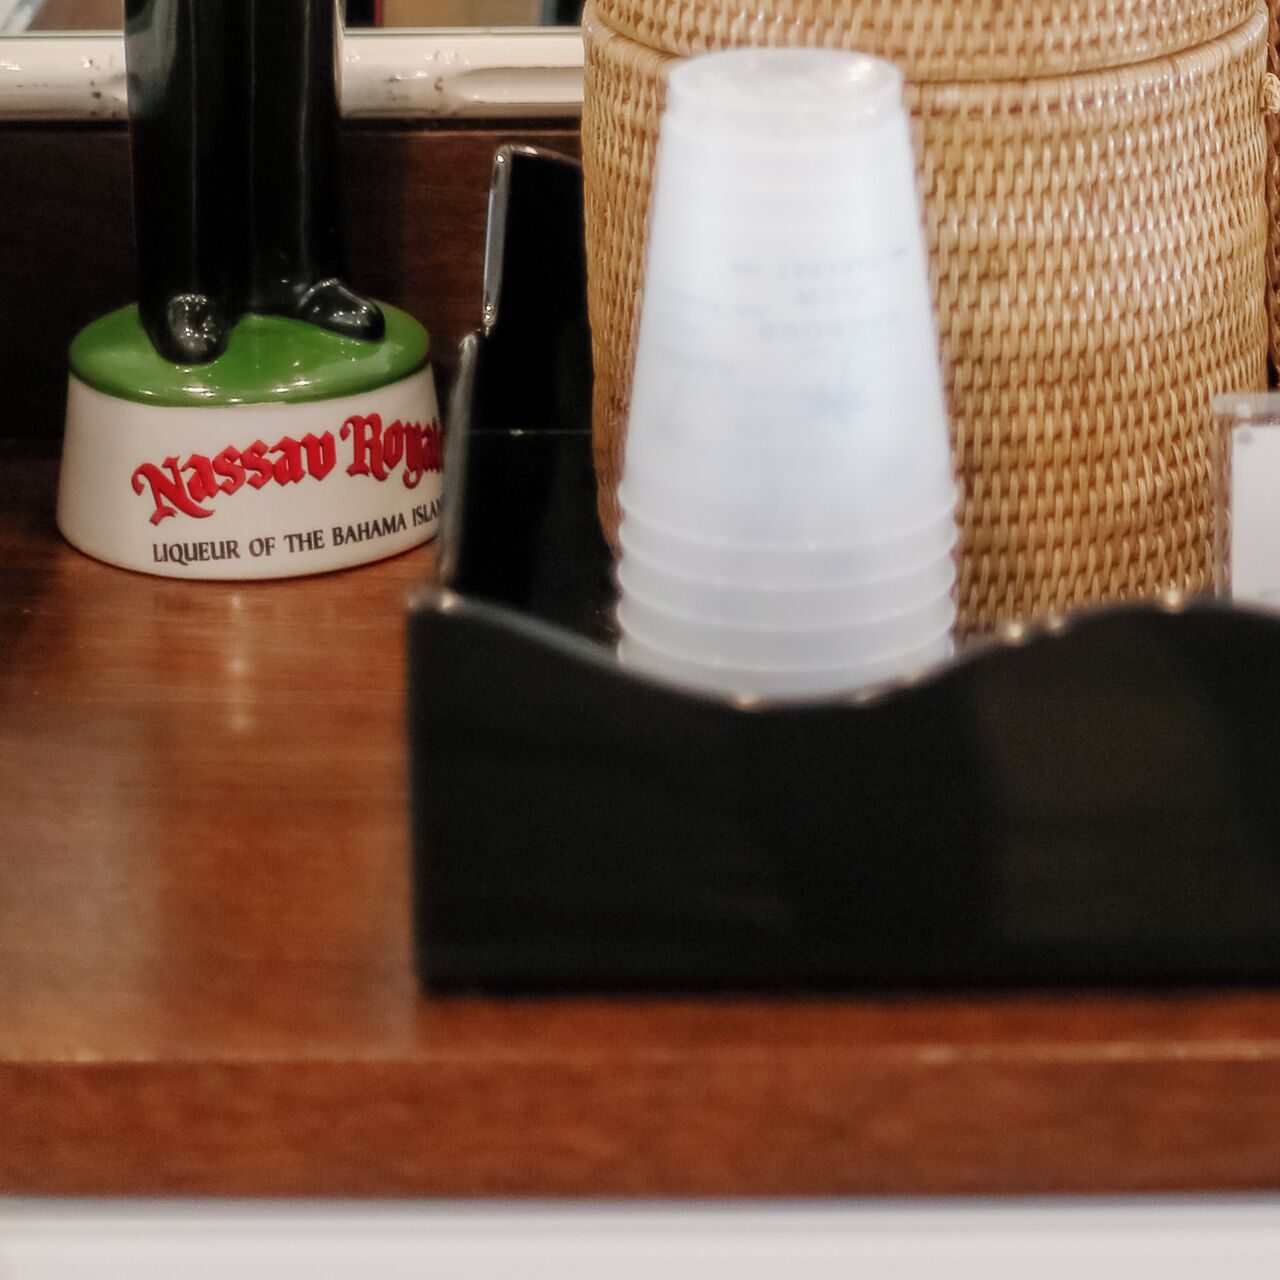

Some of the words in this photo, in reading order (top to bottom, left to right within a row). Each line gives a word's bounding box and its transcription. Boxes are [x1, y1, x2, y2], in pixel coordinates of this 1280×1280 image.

[153, 539, 241, 566] LIQUEUR
[248, 535, 276, 557] OF
[284, 529, 325, 553] THE
[332, 512, 407, 547] BAHAMA
